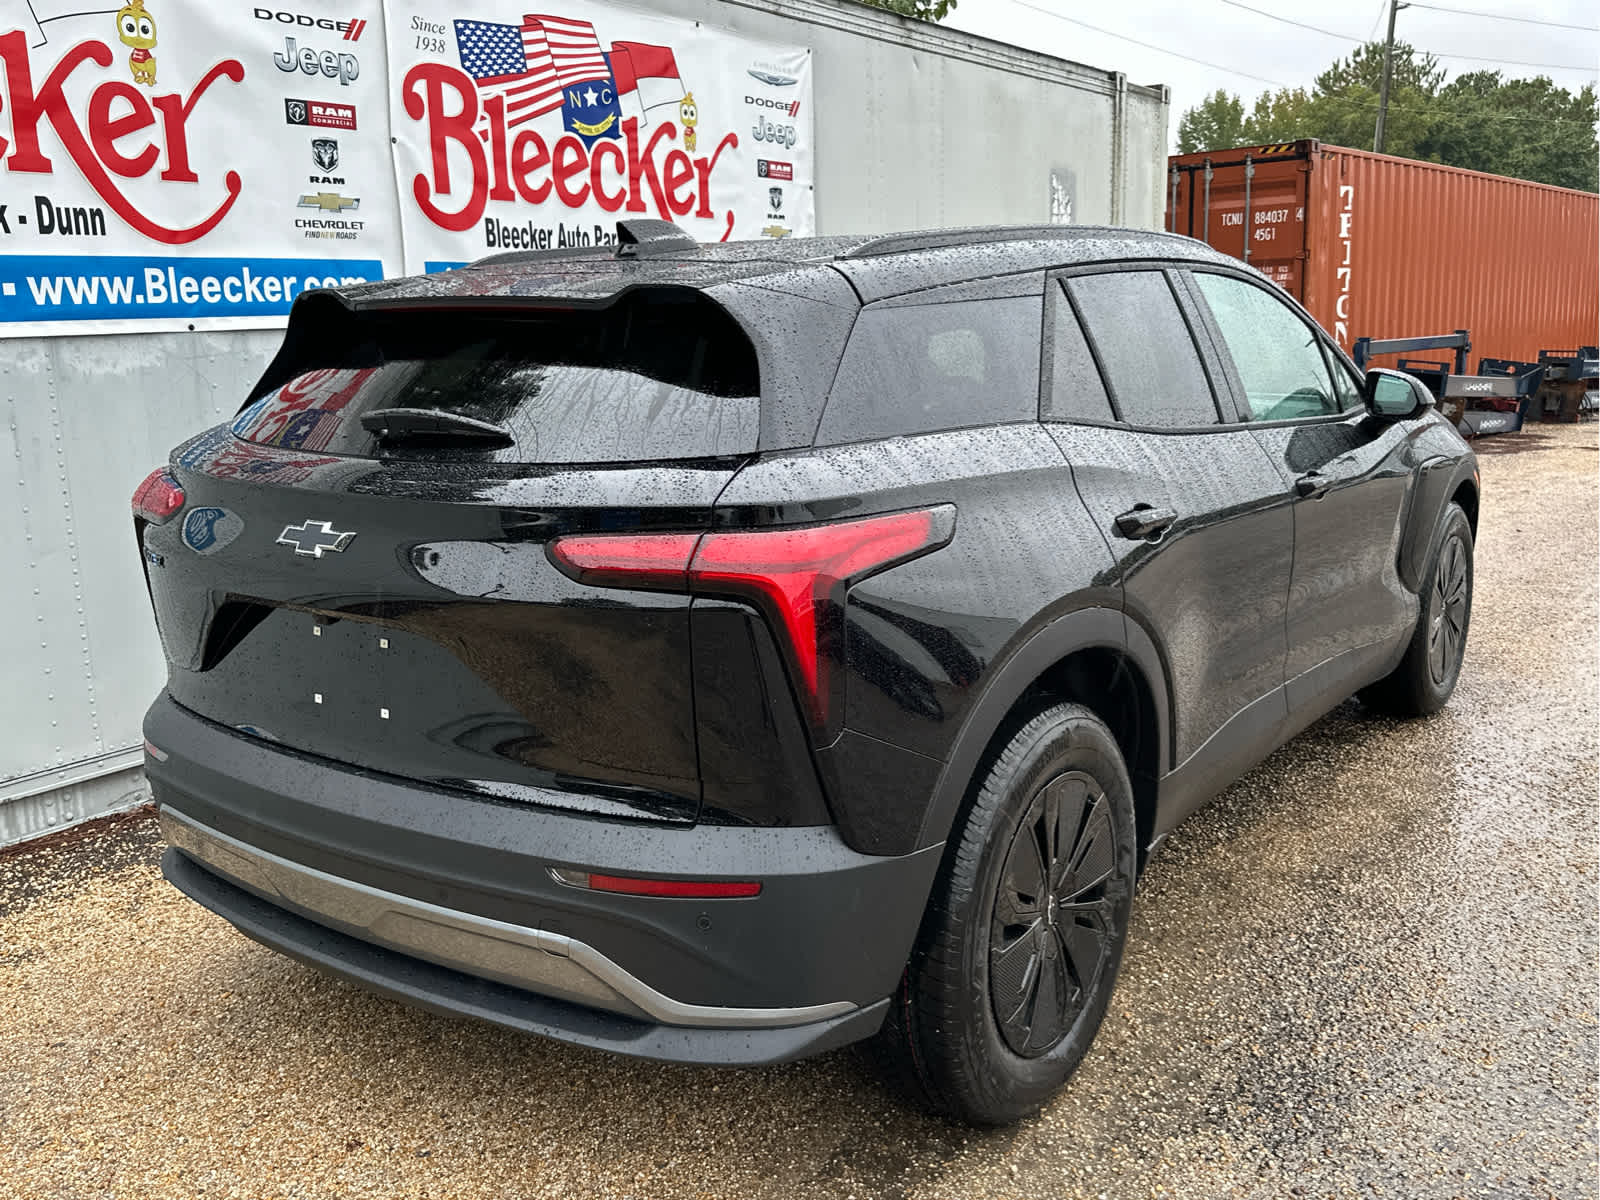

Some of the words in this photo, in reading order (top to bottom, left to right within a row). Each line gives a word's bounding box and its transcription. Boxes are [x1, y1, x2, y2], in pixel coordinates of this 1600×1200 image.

[253, 7, 353, 33] DODGE
[410, 15, 446, 35] Since
[415, 35, 446, 54] 1938
[273, 36, 360, 86] Jeep
[311, 105, 353, 118] RAM
[745, 95, 794, 111] DODGE
[752, 115, 796, 150] Jeep
[402, 62, 740, 243] Bleecker
[309, 175, 346, 185] RAM
[34, 195, 107, 236] Dunn
[294, 218, 366, 231] CHEVROLET
[1221, 212, 1244, 227] TCNU
[1254, 209, 1289, 225] 884037
[484, 216, 553, 250] Bleecker
[557, 222, 591, 249] Auto
[594, 224, 618, 247] Par
[1253, 227, 1276, 241] 45G1
[25, 267, 368, 305] www.Bleeckerc
